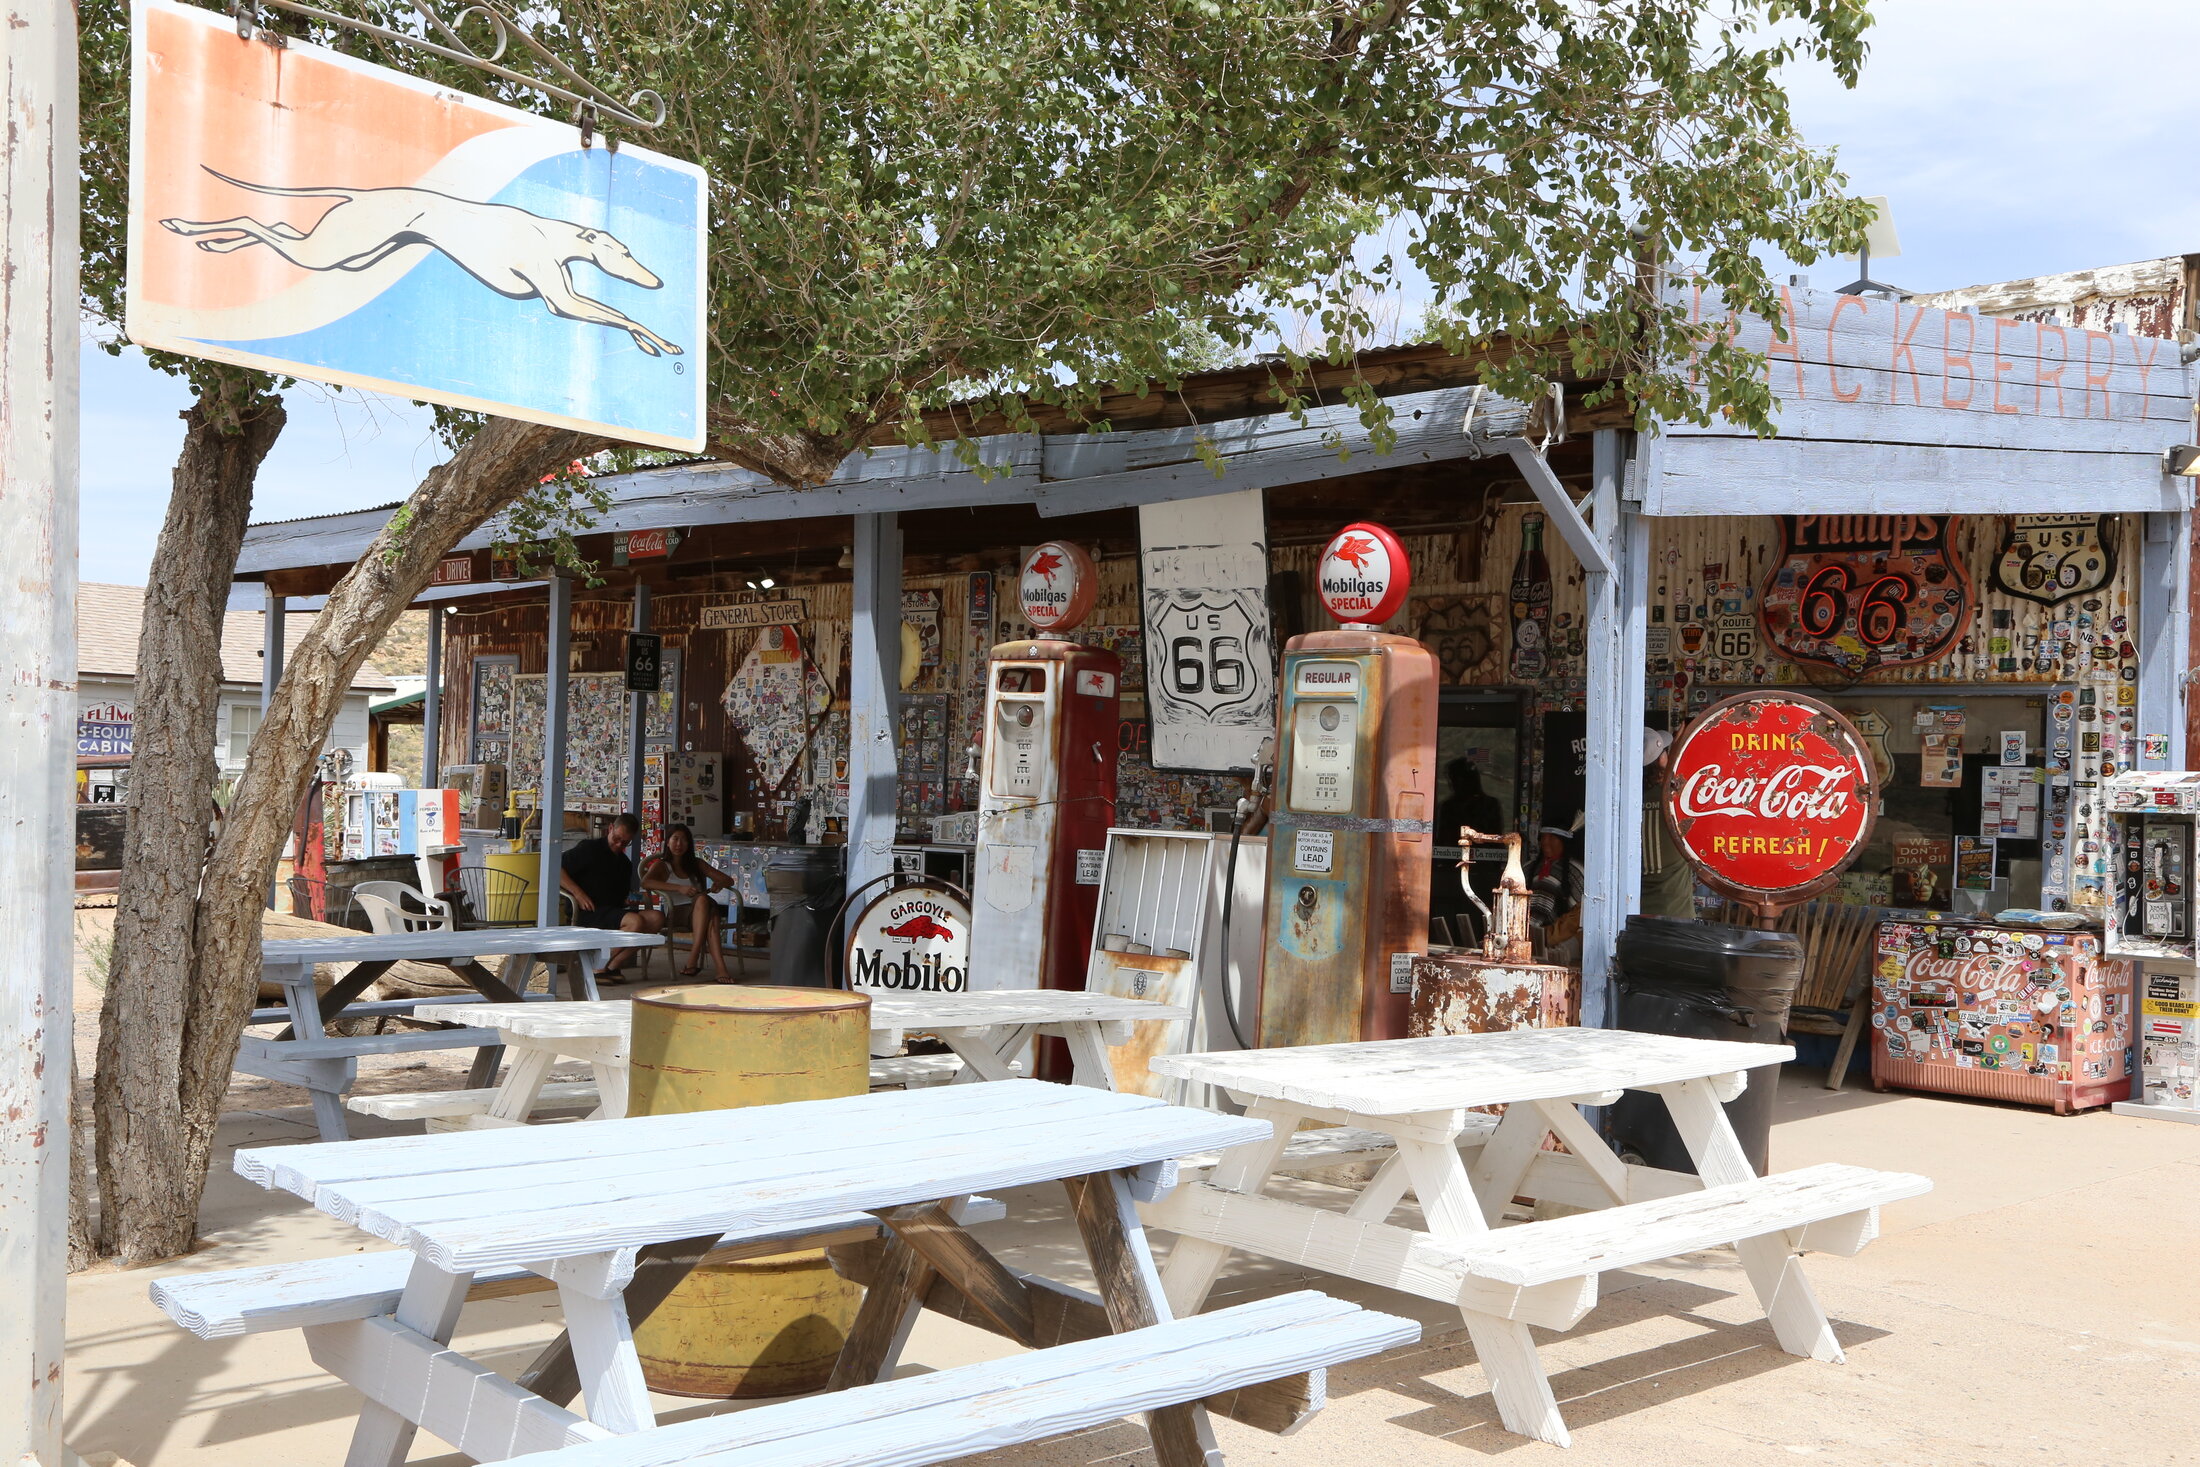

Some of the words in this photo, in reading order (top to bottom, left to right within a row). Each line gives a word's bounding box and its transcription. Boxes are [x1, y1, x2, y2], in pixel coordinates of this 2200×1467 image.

[1691, 272, 2158, 421] HACKBERRY
[614, 537, 628, 545] SOLD
[665, 537, 680, 546] COLD
[614, 545, 628, 553] HERE
[447, 559, 469, 580] DRIVE
[2020, 550, 2082, 591] 66
[1322, 577, 1384, 597] Mobilgas
[1022, 588, 1067, 606] Mobilgas
[1331, 597, 1374, 610] SPECIAL
[1800, 565, 1917, 647] 66
[703, 608, 758, 627] GENERAL
[760, 604, 800, 623] STORE
[1028, 605, 1060, 617] SPECIAL
[1722, 619, 1751, 627] ROUTE
[1721, 632, 1751, 656] 66
[635, 656, 653, 671] 66
[1171, 636, 1245, 695] 66
[1305, 672, 1351, 684] REGULAR
[1680, 764, 1856, 819] Coca-Cola
[1909, 838, 1930, 846] WE
[1300, 845, 1328, 853] CONTAINS
[1900, 847, 1940, 856] DON'T
[1302, 853, 1324, 863] LEAD
[1929, 855, 1947, 864] 911
[1870, 894, 1887, 904] ICE
[891, 901, 948, 923] GARGOYLE
[2163, 1036, 2178, 1044] 4x4
